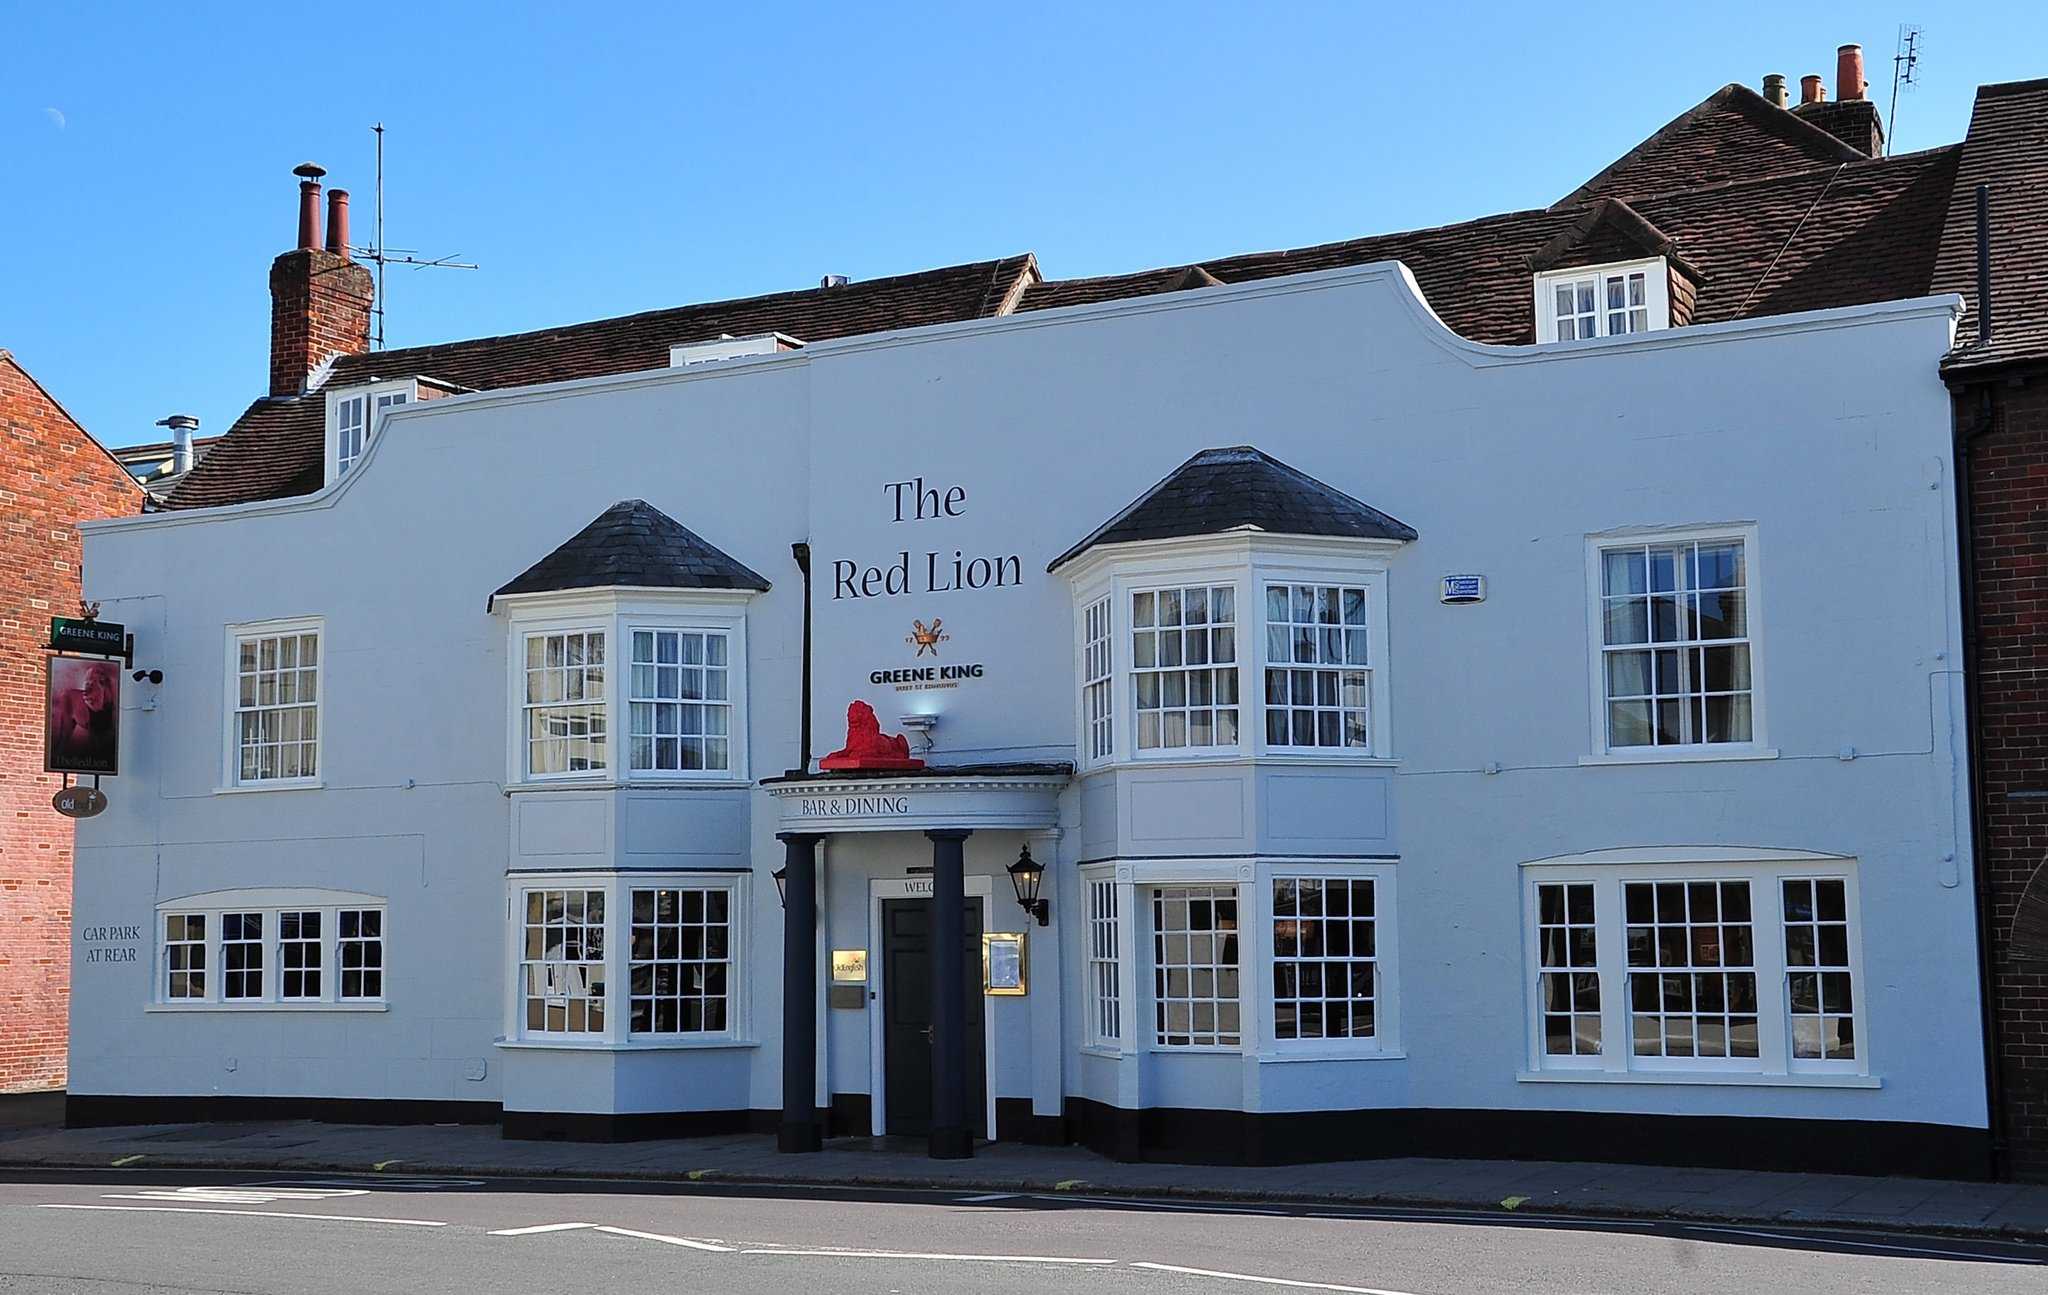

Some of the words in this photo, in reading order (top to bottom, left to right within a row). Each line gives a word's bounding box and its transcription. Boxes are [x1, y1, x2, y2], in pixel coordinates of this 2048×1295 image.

[884, 477, 967, 522] The
[832, 551, 912, 600] Red
[926, 550, 1024, 593] Lion
[60, 626, 95, 638] GREENE
[97, 631, 120, 641] KING
[870, 667, 936, 684] GREENE
[940, 664, 984, 680] KING
[802, 799, 827, 816] BAR
[830, 799, 841, 815] &
[846, 796, 908, 814] DINING
[83, 927, 107, 941] CAR
[109, 926, 140, 940] PARK
[86, 948, 102, 963] AT
[104, 947, 136, 962] REAR
